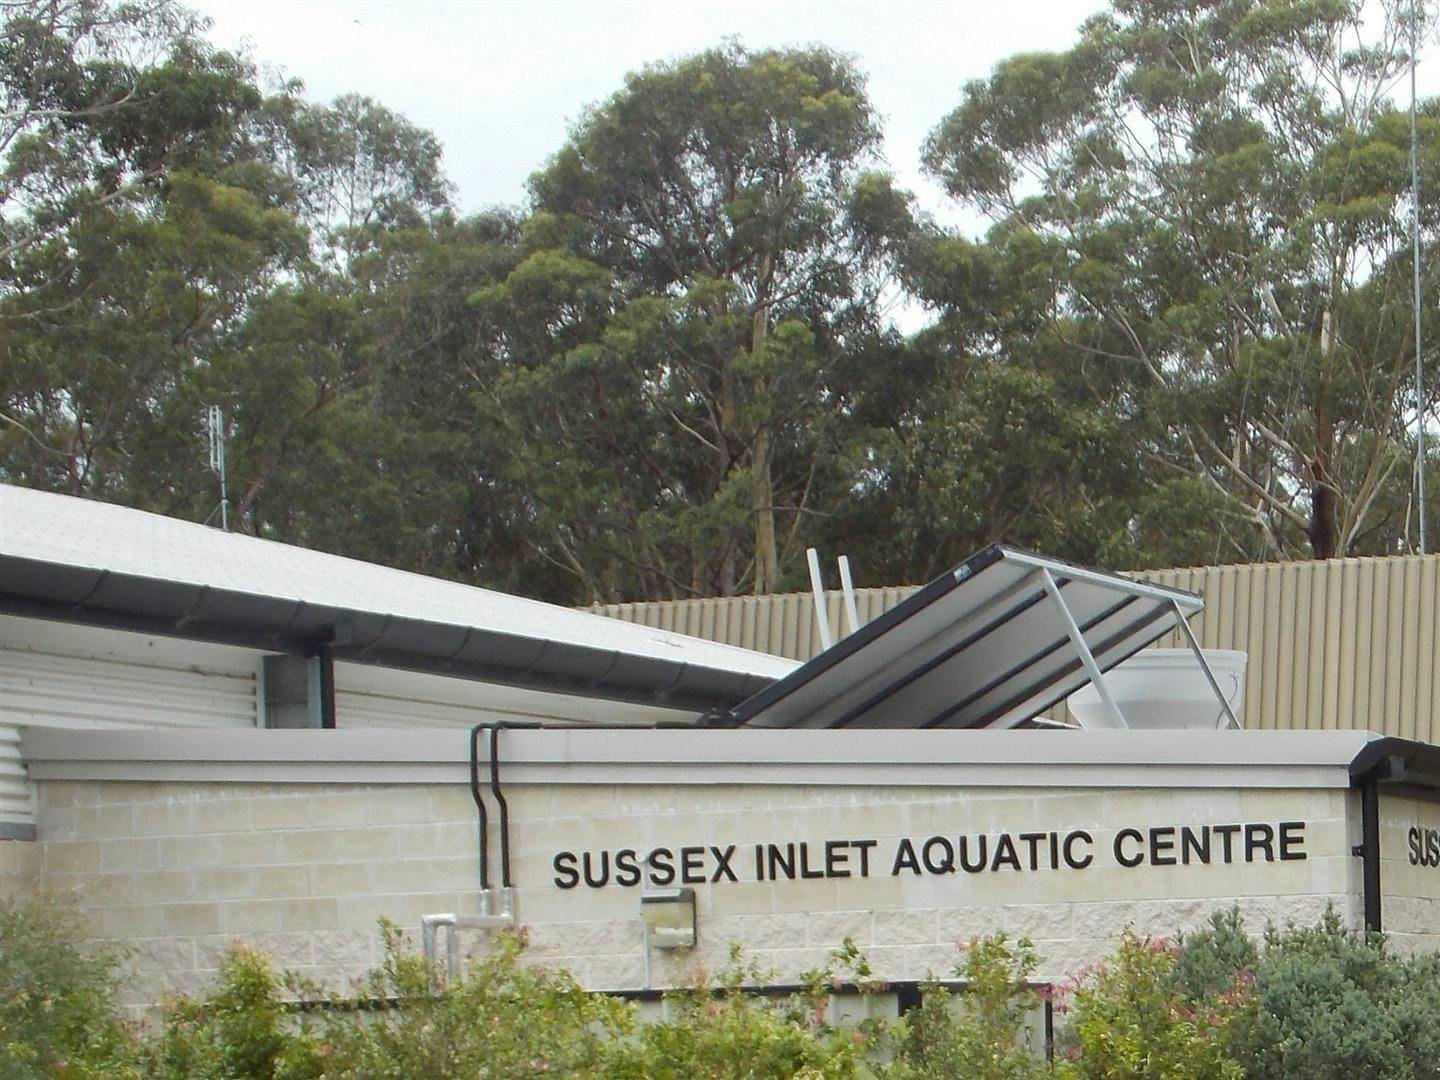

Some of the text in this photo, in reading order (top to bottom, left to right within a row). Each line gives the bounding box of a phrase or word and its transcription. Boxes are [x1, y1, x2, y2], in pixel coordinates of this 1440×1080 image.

[553, 821, 1308, 890] SUSSEX INLET AQUATIC CENTRE
